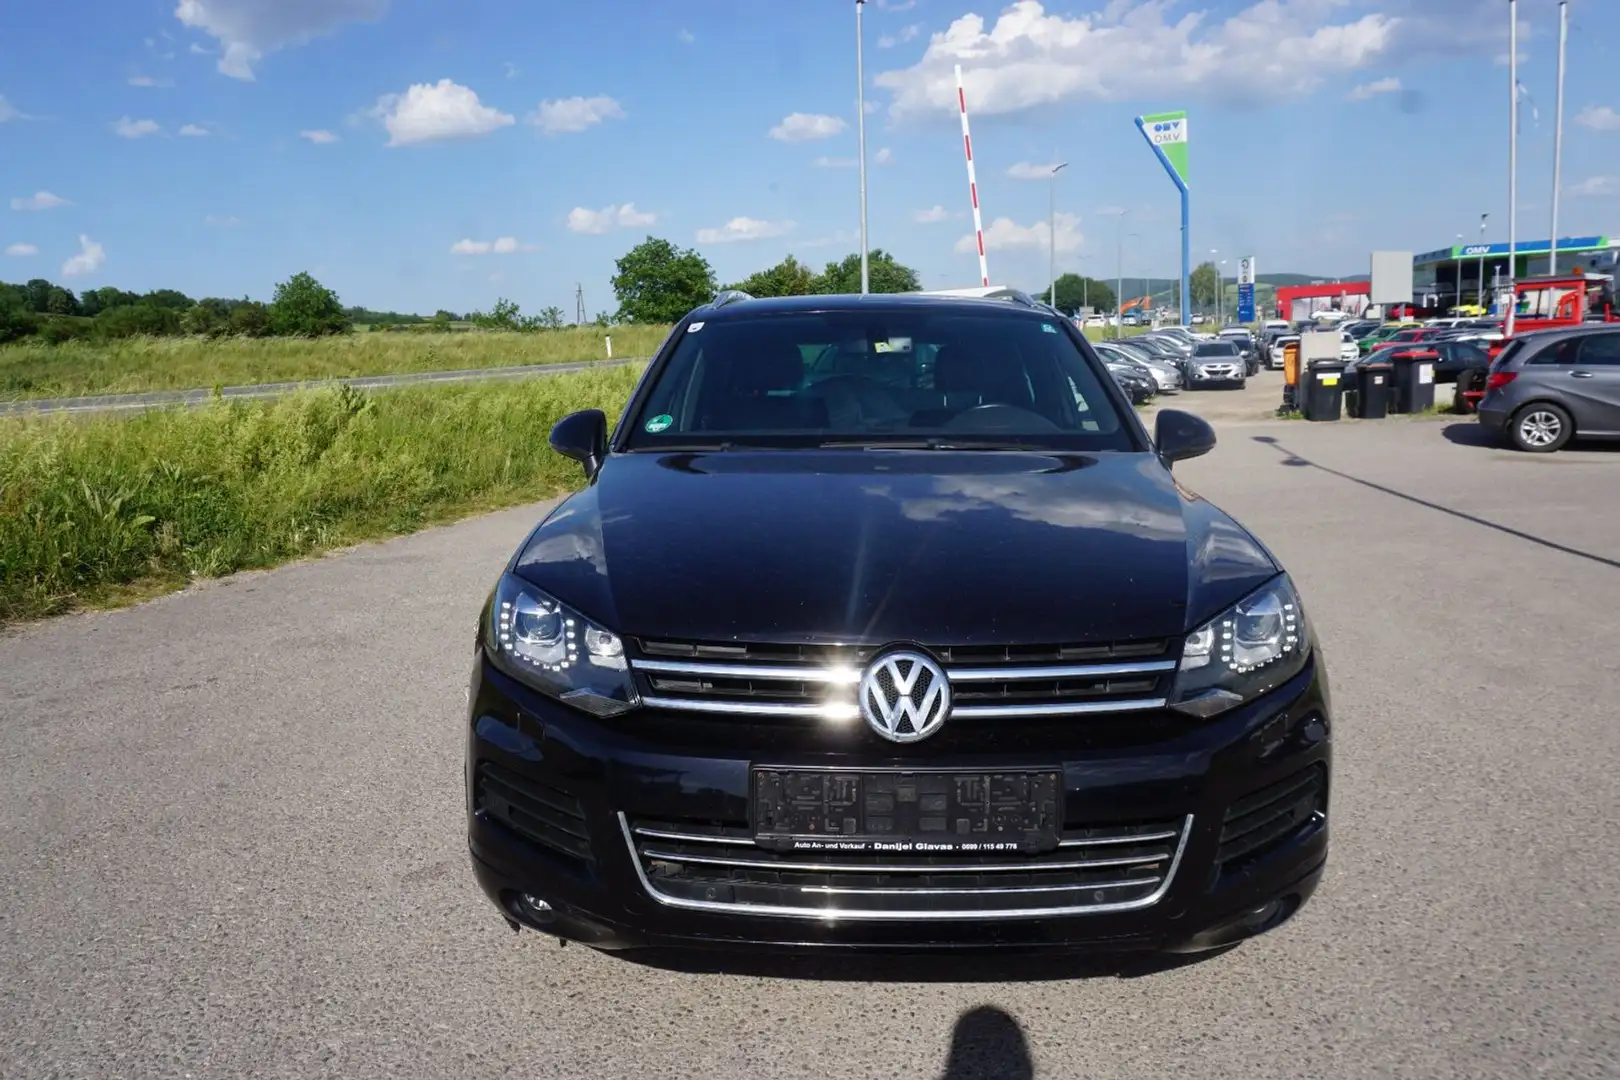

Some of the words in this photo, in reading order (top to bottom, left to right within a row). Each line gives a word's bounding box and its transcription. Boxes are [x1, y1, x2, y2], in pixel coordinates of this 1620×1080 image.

[1154, 133, 1181, 144] OMV
[1465, 245, 1491, 255] OMV
[794, 841, 811, 849] Auto
[839, 842, 865, 850] Verkauf
[874, 842, 912, 851] Danijel
[983, 842, 995, 850] 115
